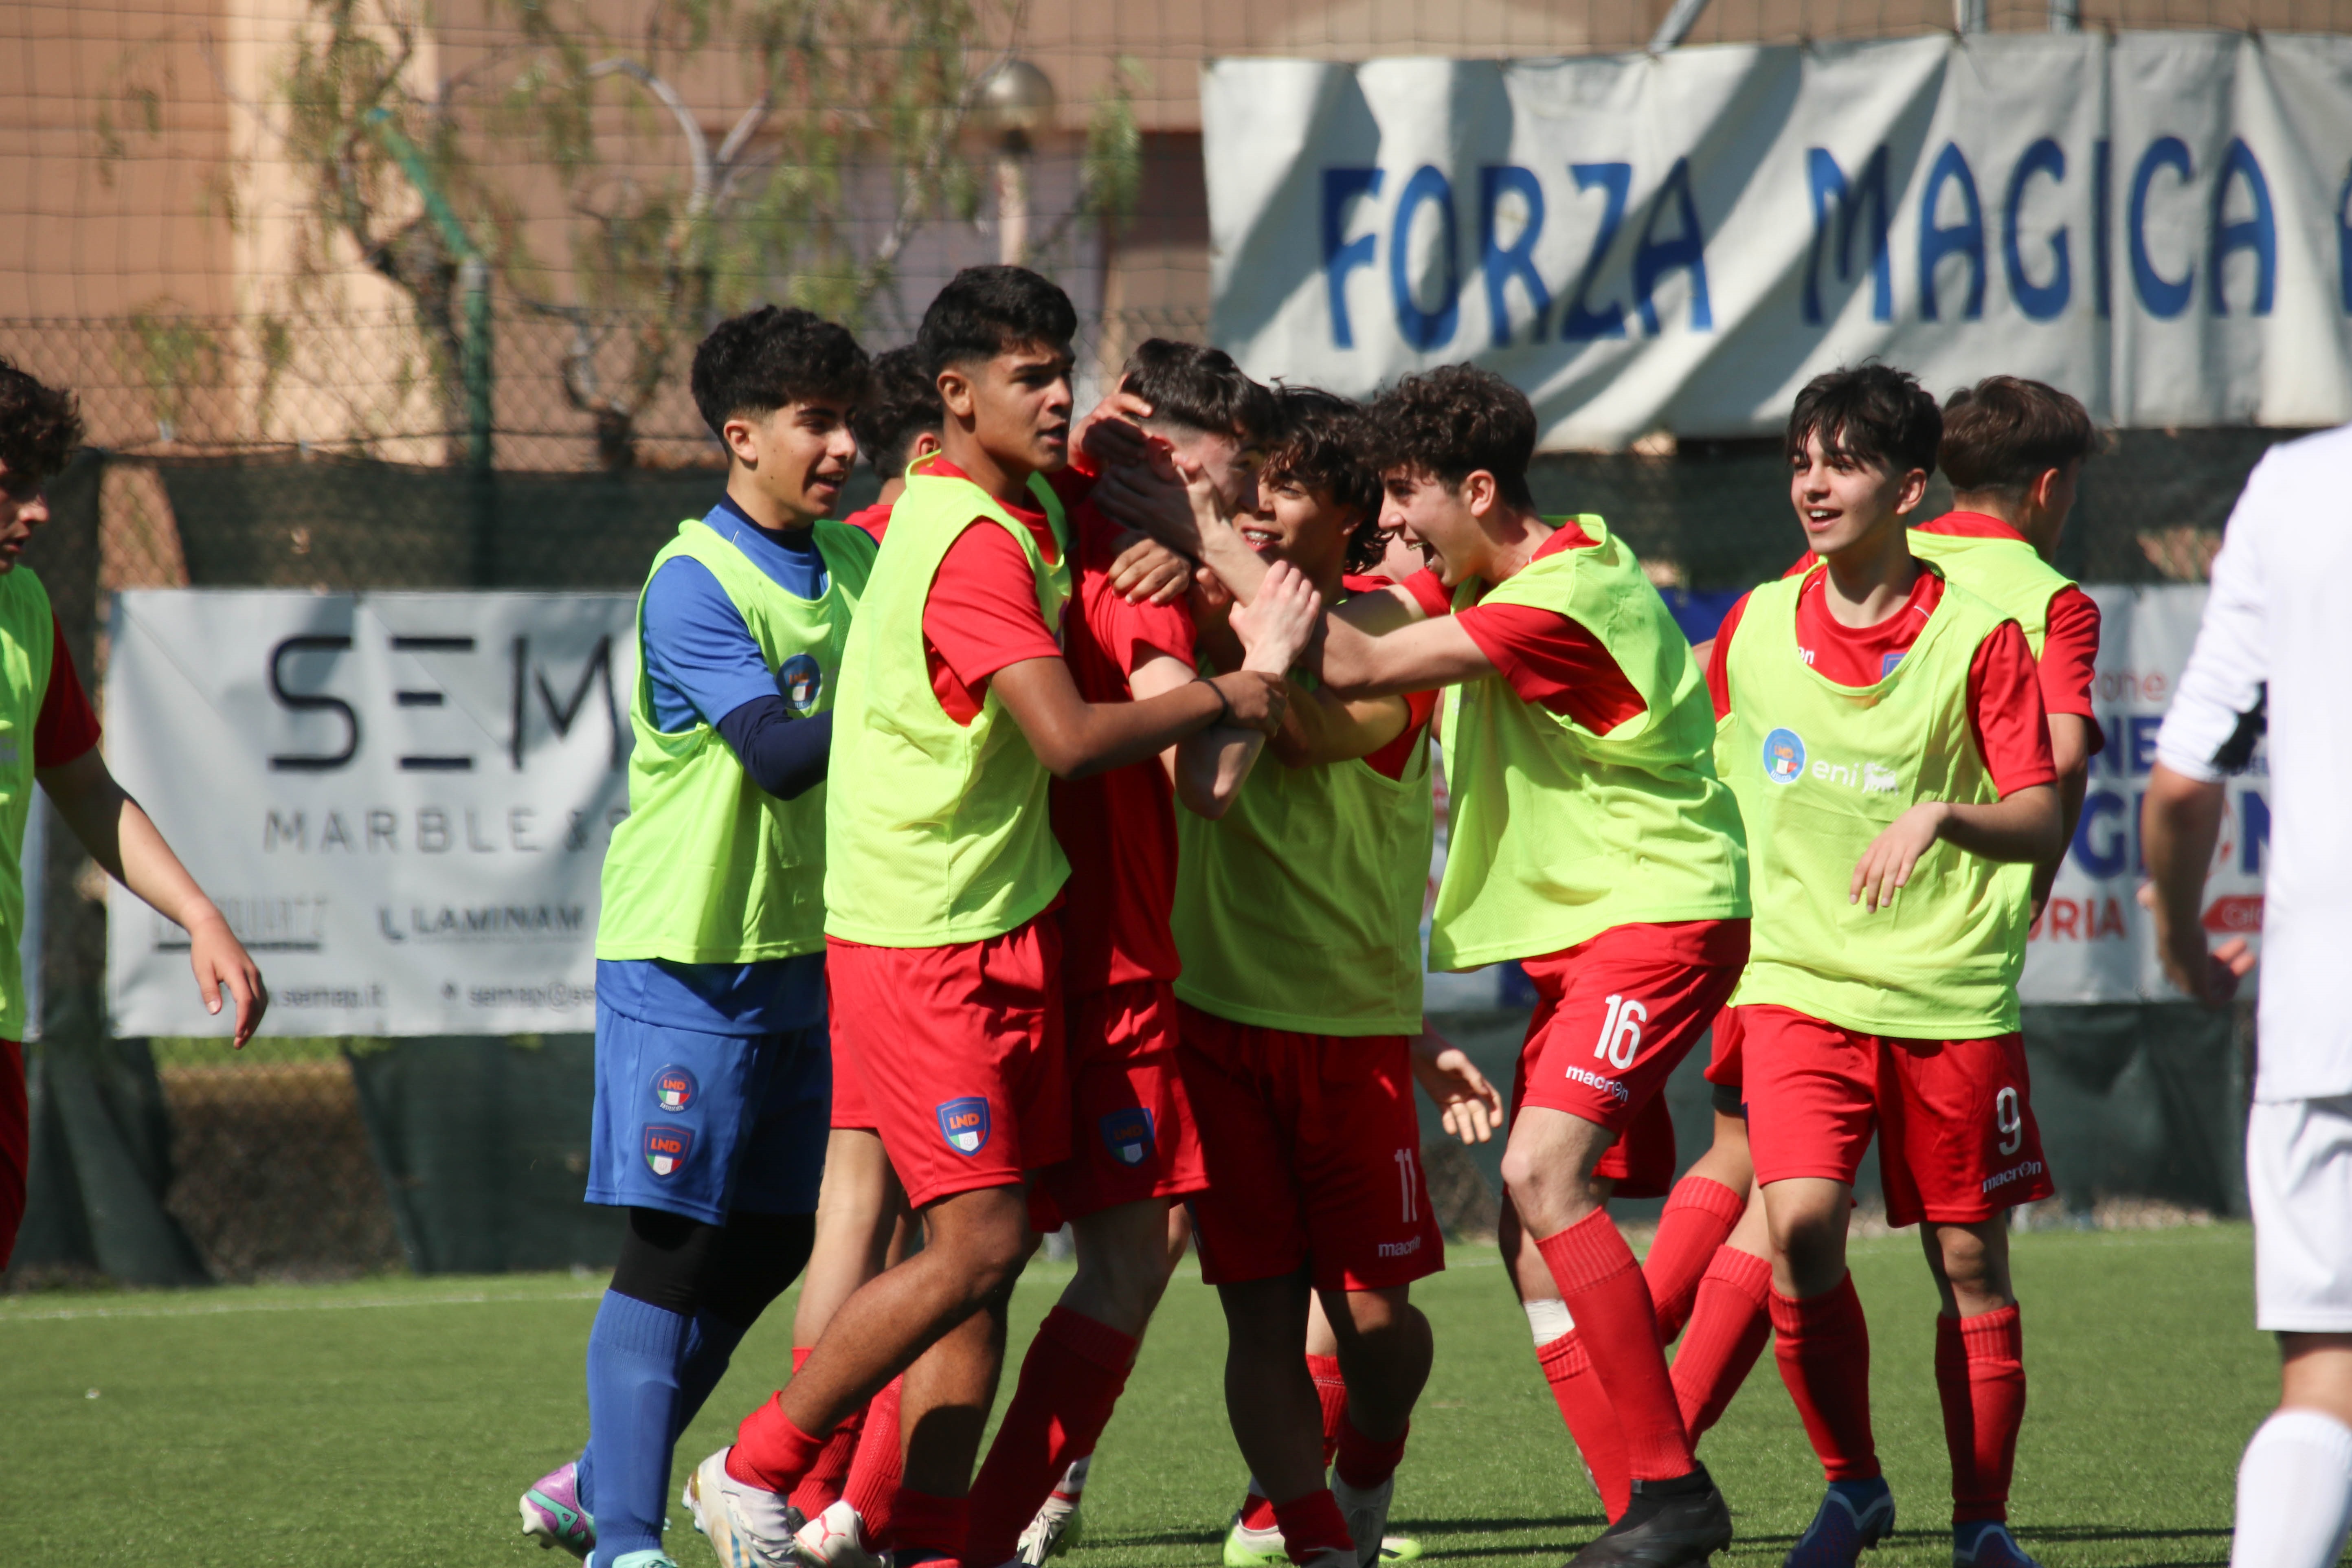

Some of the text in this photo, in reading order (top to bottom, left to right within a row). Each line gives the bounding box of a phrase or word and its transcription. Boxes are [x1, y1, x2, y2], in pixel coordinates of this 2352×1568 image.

[1320, 156, 1714, 352] FORZA
[1804, 135, 2277, 325] MAGICA
[267, 633, 621, 772] SEM
[1812, 760, 1860, 787] eni
[263, 806, 542, 854] MARBLE
[1593, 994, 1647, 1069] 16
[663, 1079, 686, 1091] LND
[1565, 1065, 1629, 1102] macron
[949, 1113, 980, 1129] LND
[1996, 1087, 2022, 1155] 9
[650, 1138, 681, 1153] LND
[1395, 1148, 1417, 1223] 11
[1983, 1161, 2042, 1193] macron
